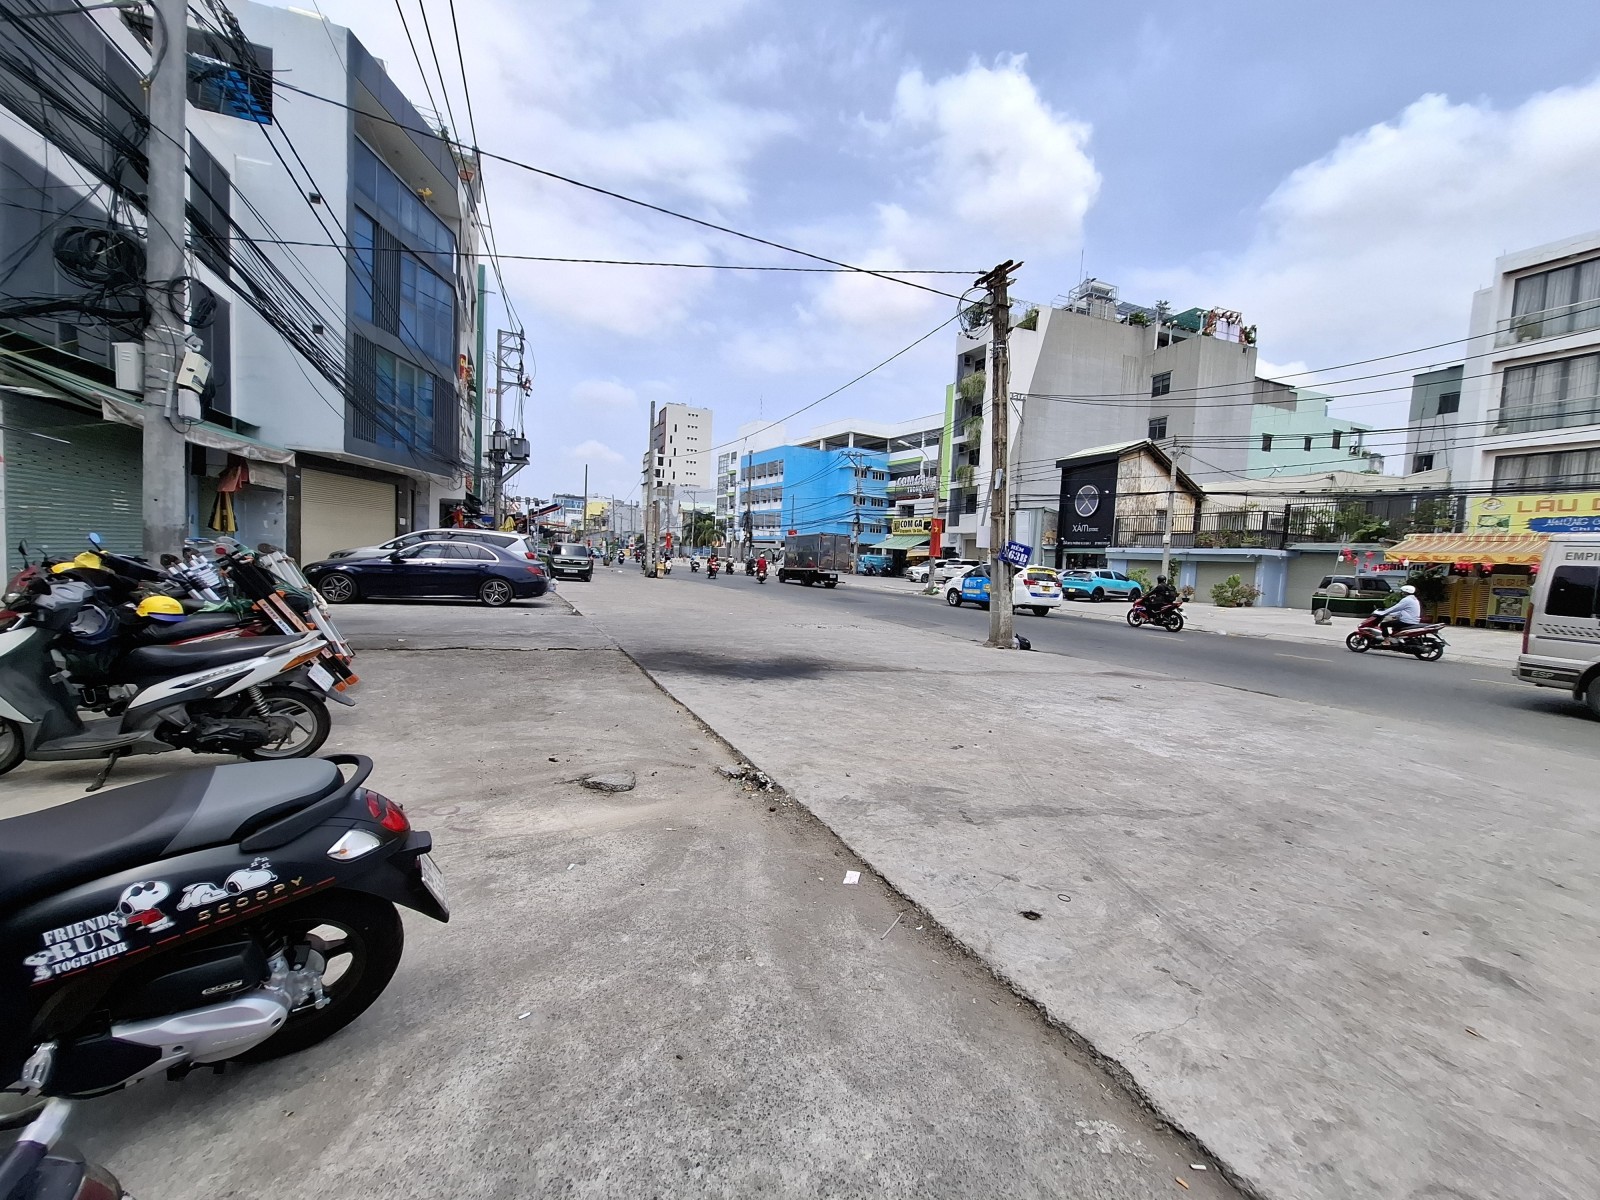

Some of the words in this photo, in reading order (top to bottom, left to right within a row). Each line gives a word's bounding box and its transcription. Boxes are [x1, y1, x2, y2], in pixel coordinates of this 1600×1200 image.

[1565, 551, 1600, 561] EMPI
[1531, 670, 1555, 679] ESP
[198, 876, 303, 921] SCOOPY
[42, 911, 119, 946] FRIENDS
[48, 925, 121, 963] RUN
[52, 942, 128, 974] TOGETHER
